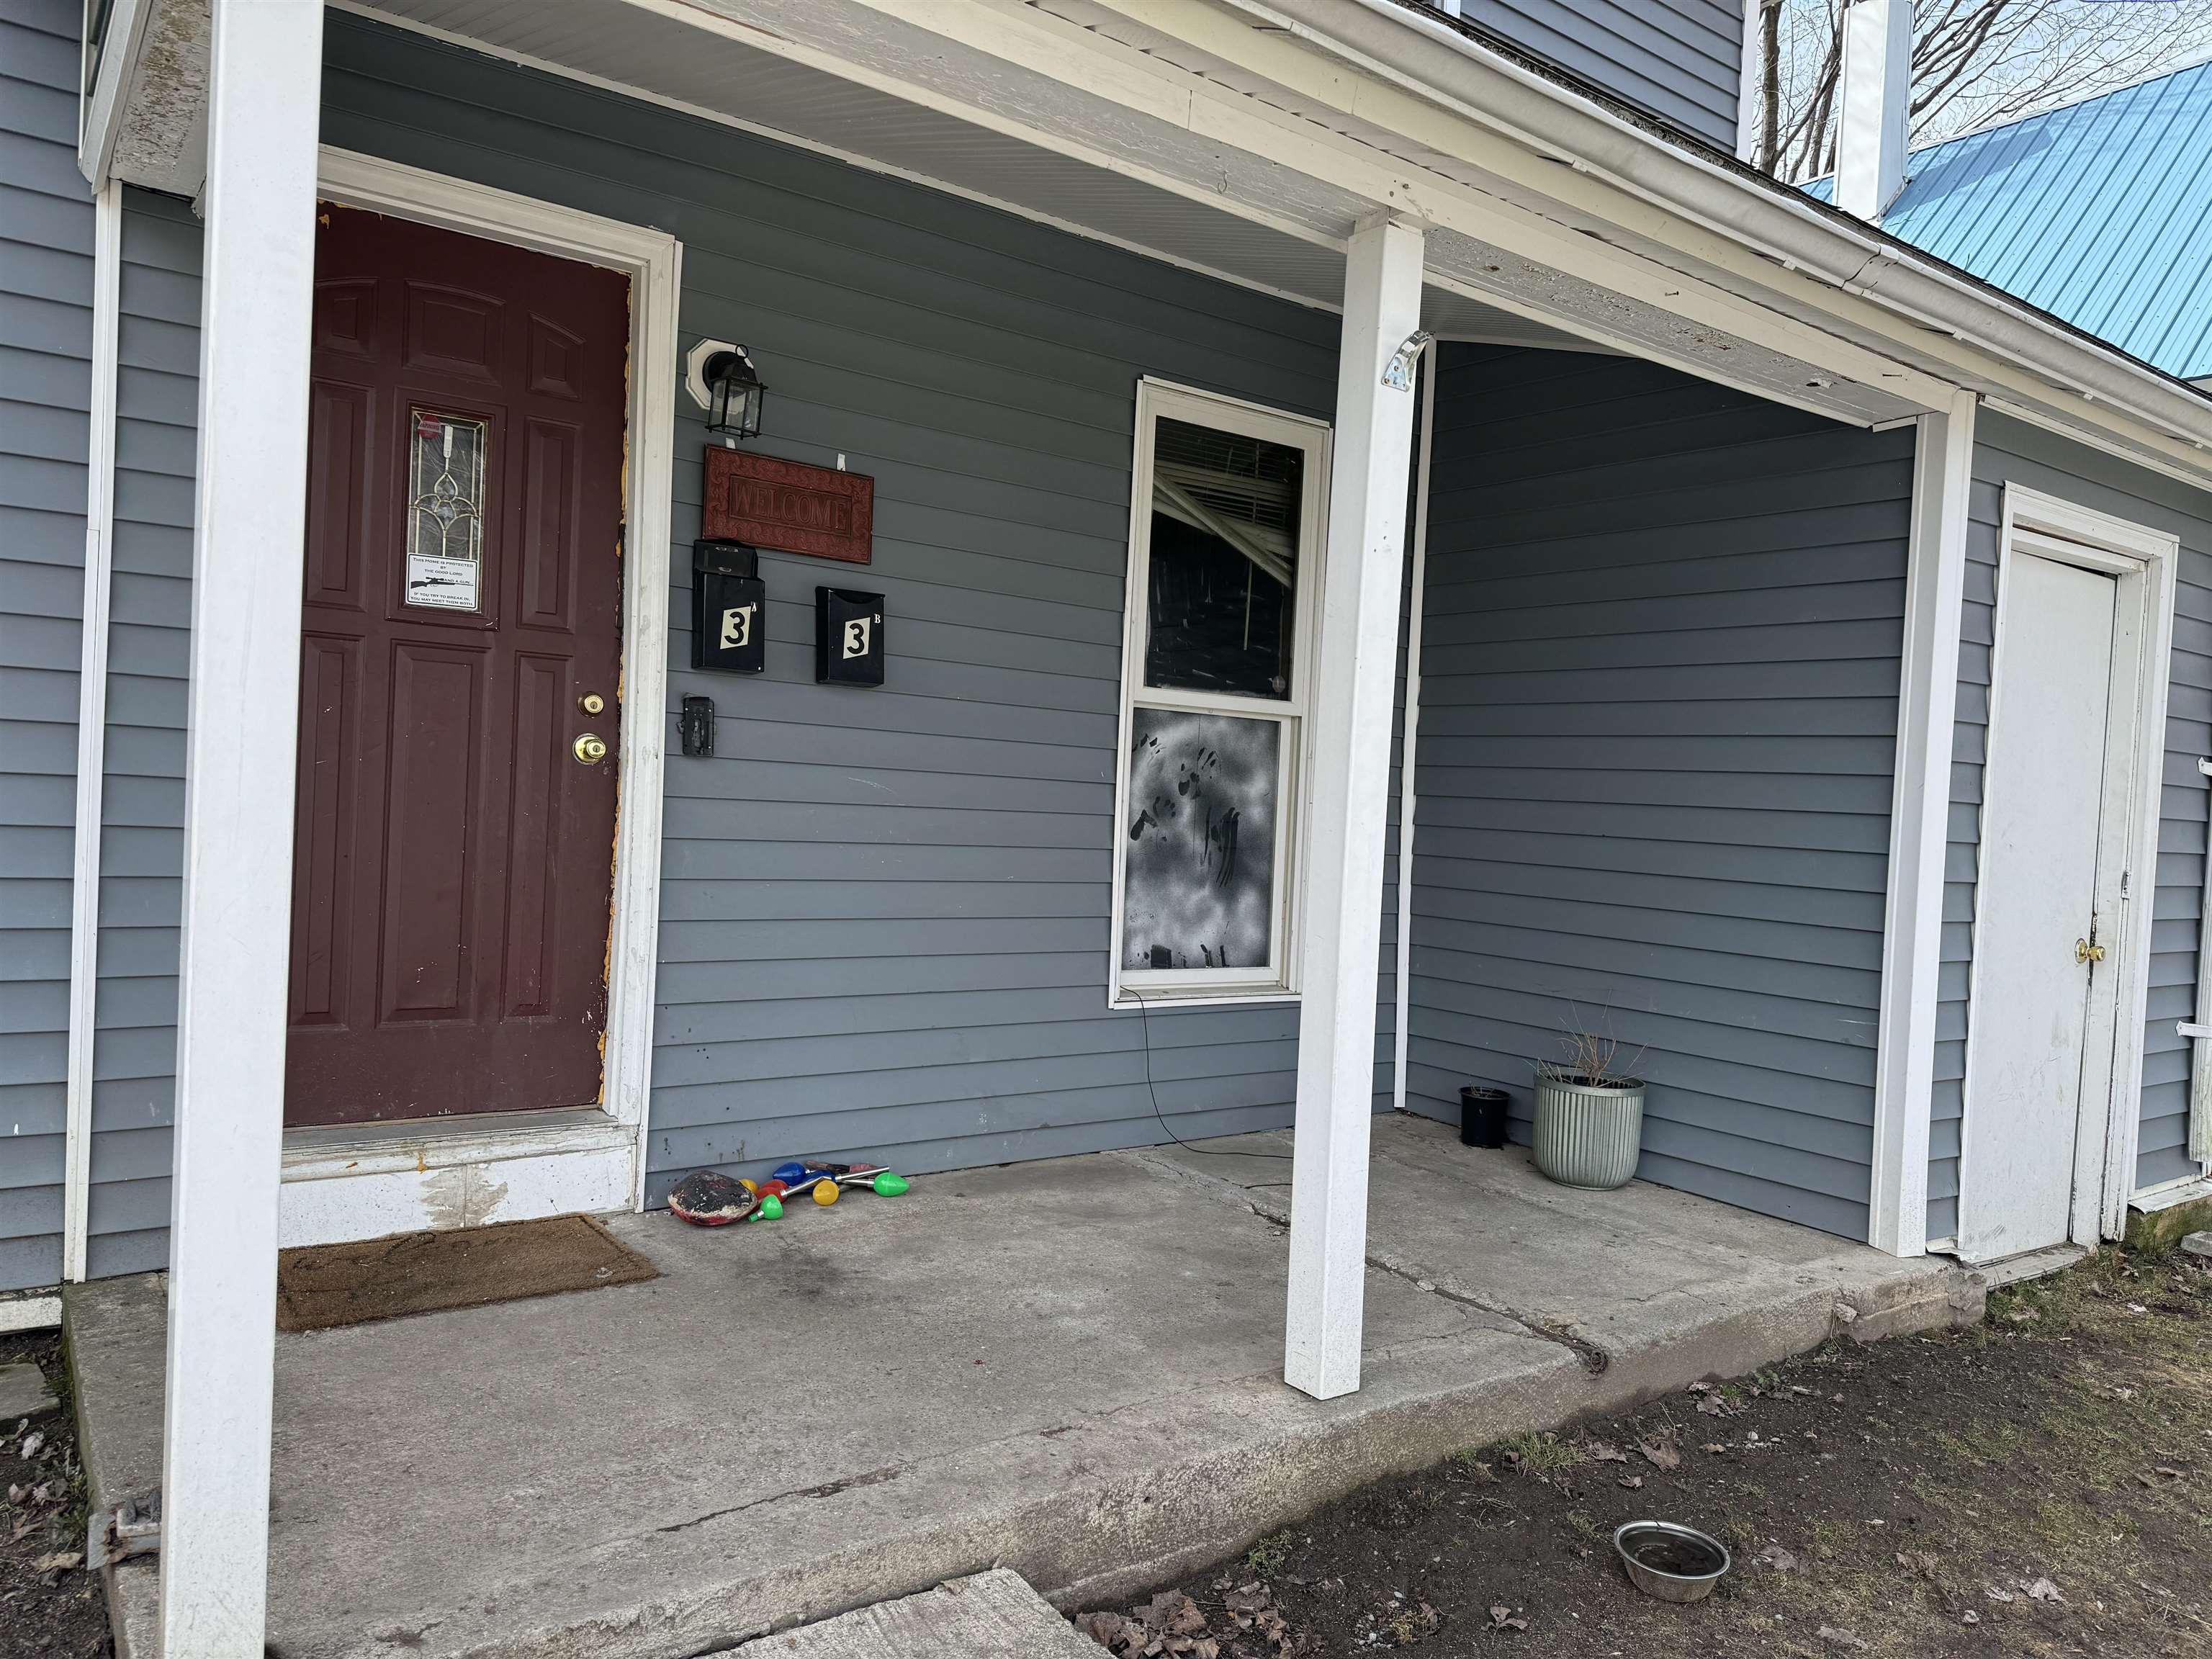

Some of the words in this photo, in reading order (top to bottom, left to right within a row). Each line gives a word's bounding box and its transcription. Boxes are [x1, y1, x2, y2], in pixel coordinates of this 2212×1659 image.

[734, 482, 847, 531] WELCOME
[724, 612, 745, 644] 3
[750, 601, 757, 612] A
[847, 622, 864, 654] 3
[874, 613, 881, 624] B
